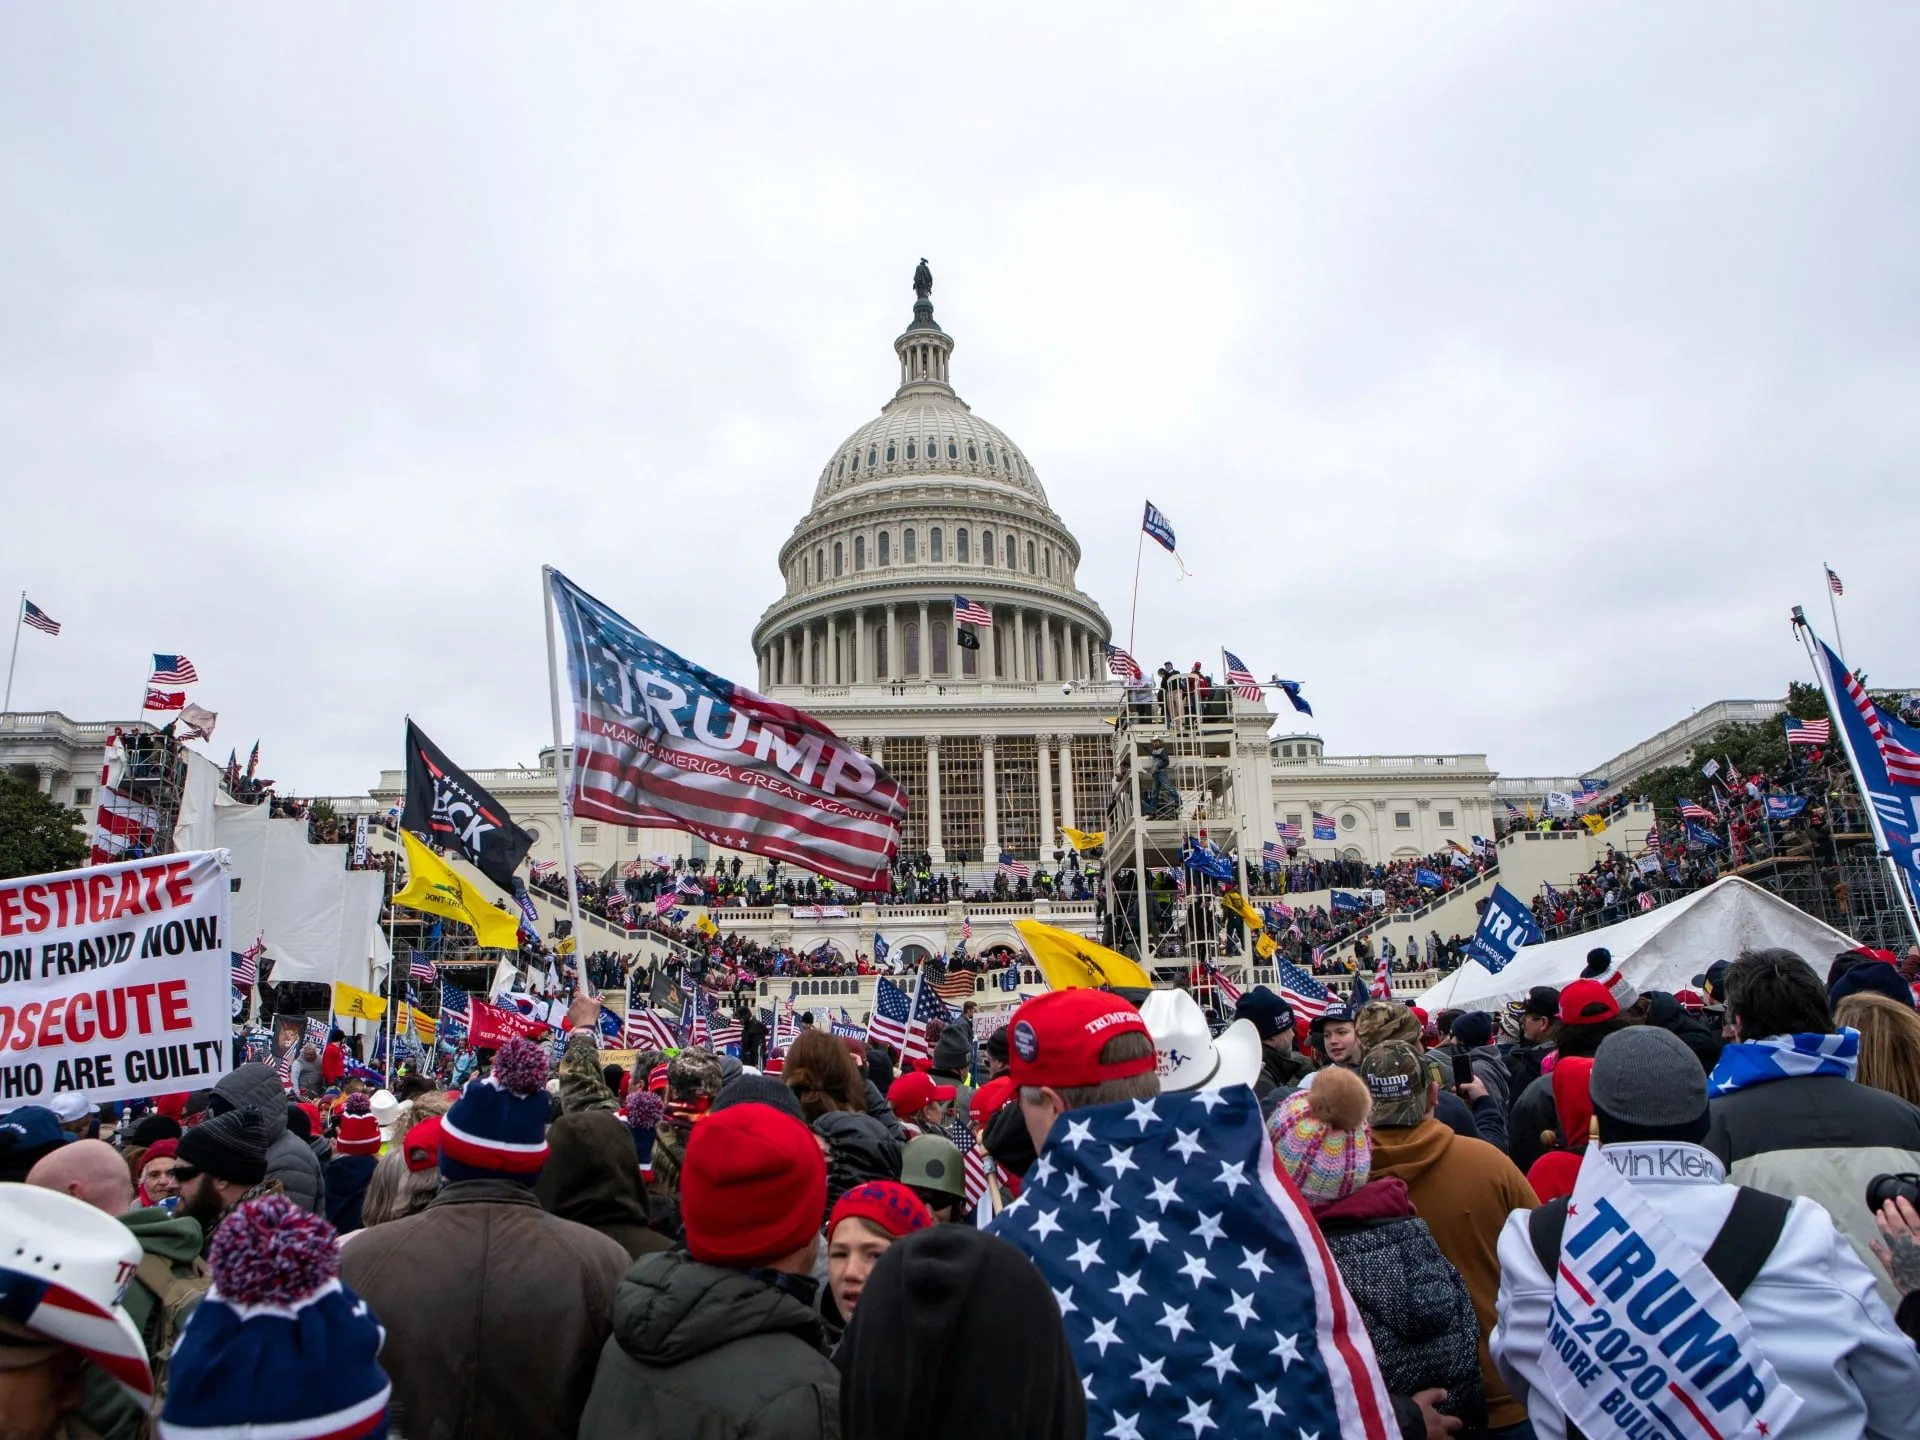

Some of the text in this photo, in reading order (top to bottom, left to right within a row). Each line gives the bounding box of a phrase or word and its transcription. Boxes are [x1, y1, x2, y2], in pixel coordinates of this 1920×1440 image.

[603, 650, 876, 795] TRUMP
[601, 722, 879, 821] MAKING AMERICA GREAT AGAIN!
[356, 817, 366, 864] TRUMP
[521, 893, 537, 920] TRUMP
[1335, 903, 1356, 911] LIBERTY
[41, 931, 136, 978] FRAUD
[141, 915, 222, 959] NOW.
[833, 1026, 867, 1041] TRUMP
[0, 1040, 223, 1099] HO ARE GUILTY
[1368, 1074, 1408, 1088] Trump
[1659, 1149, 1713, 1177] Klein
[1565, 1197, 1765, 1416] TRUMP
[1548, 1320, 1603, 1390] MORE
[1573, 1308, 1668, 1400] 2020
